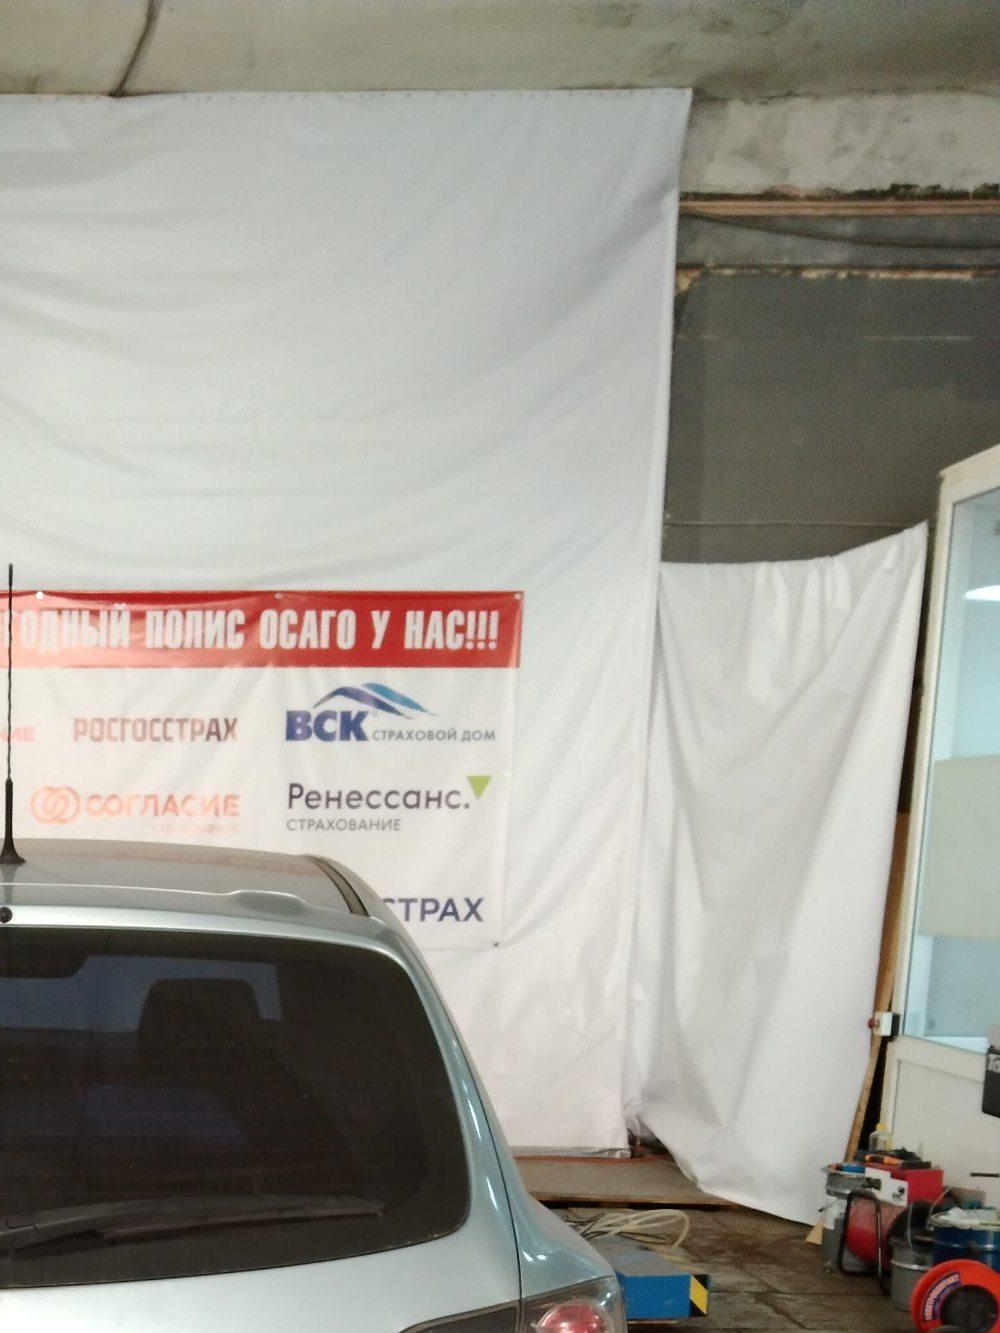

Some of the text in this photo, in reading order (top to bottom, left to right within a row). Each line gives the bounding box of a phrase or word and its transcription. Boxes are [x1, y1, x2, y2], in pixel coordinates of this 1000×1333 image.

[145, 608, 246, 650] ПОЛИС
[259, 608, 357, 650] ОСАГО
[371, 609, 391, 650] У
[404, 609, 499, 650] НАС!!!
[72, 717, 239, 742] РОСГОССТРАХ
[285, 710, 496, 742] ВСК СТРАХОВОЙ ДОМ
[84, 793, 241, 818] СОГЛАСИЕ
[286, 818, 401, 831] СТРАХОВАНИЕ
